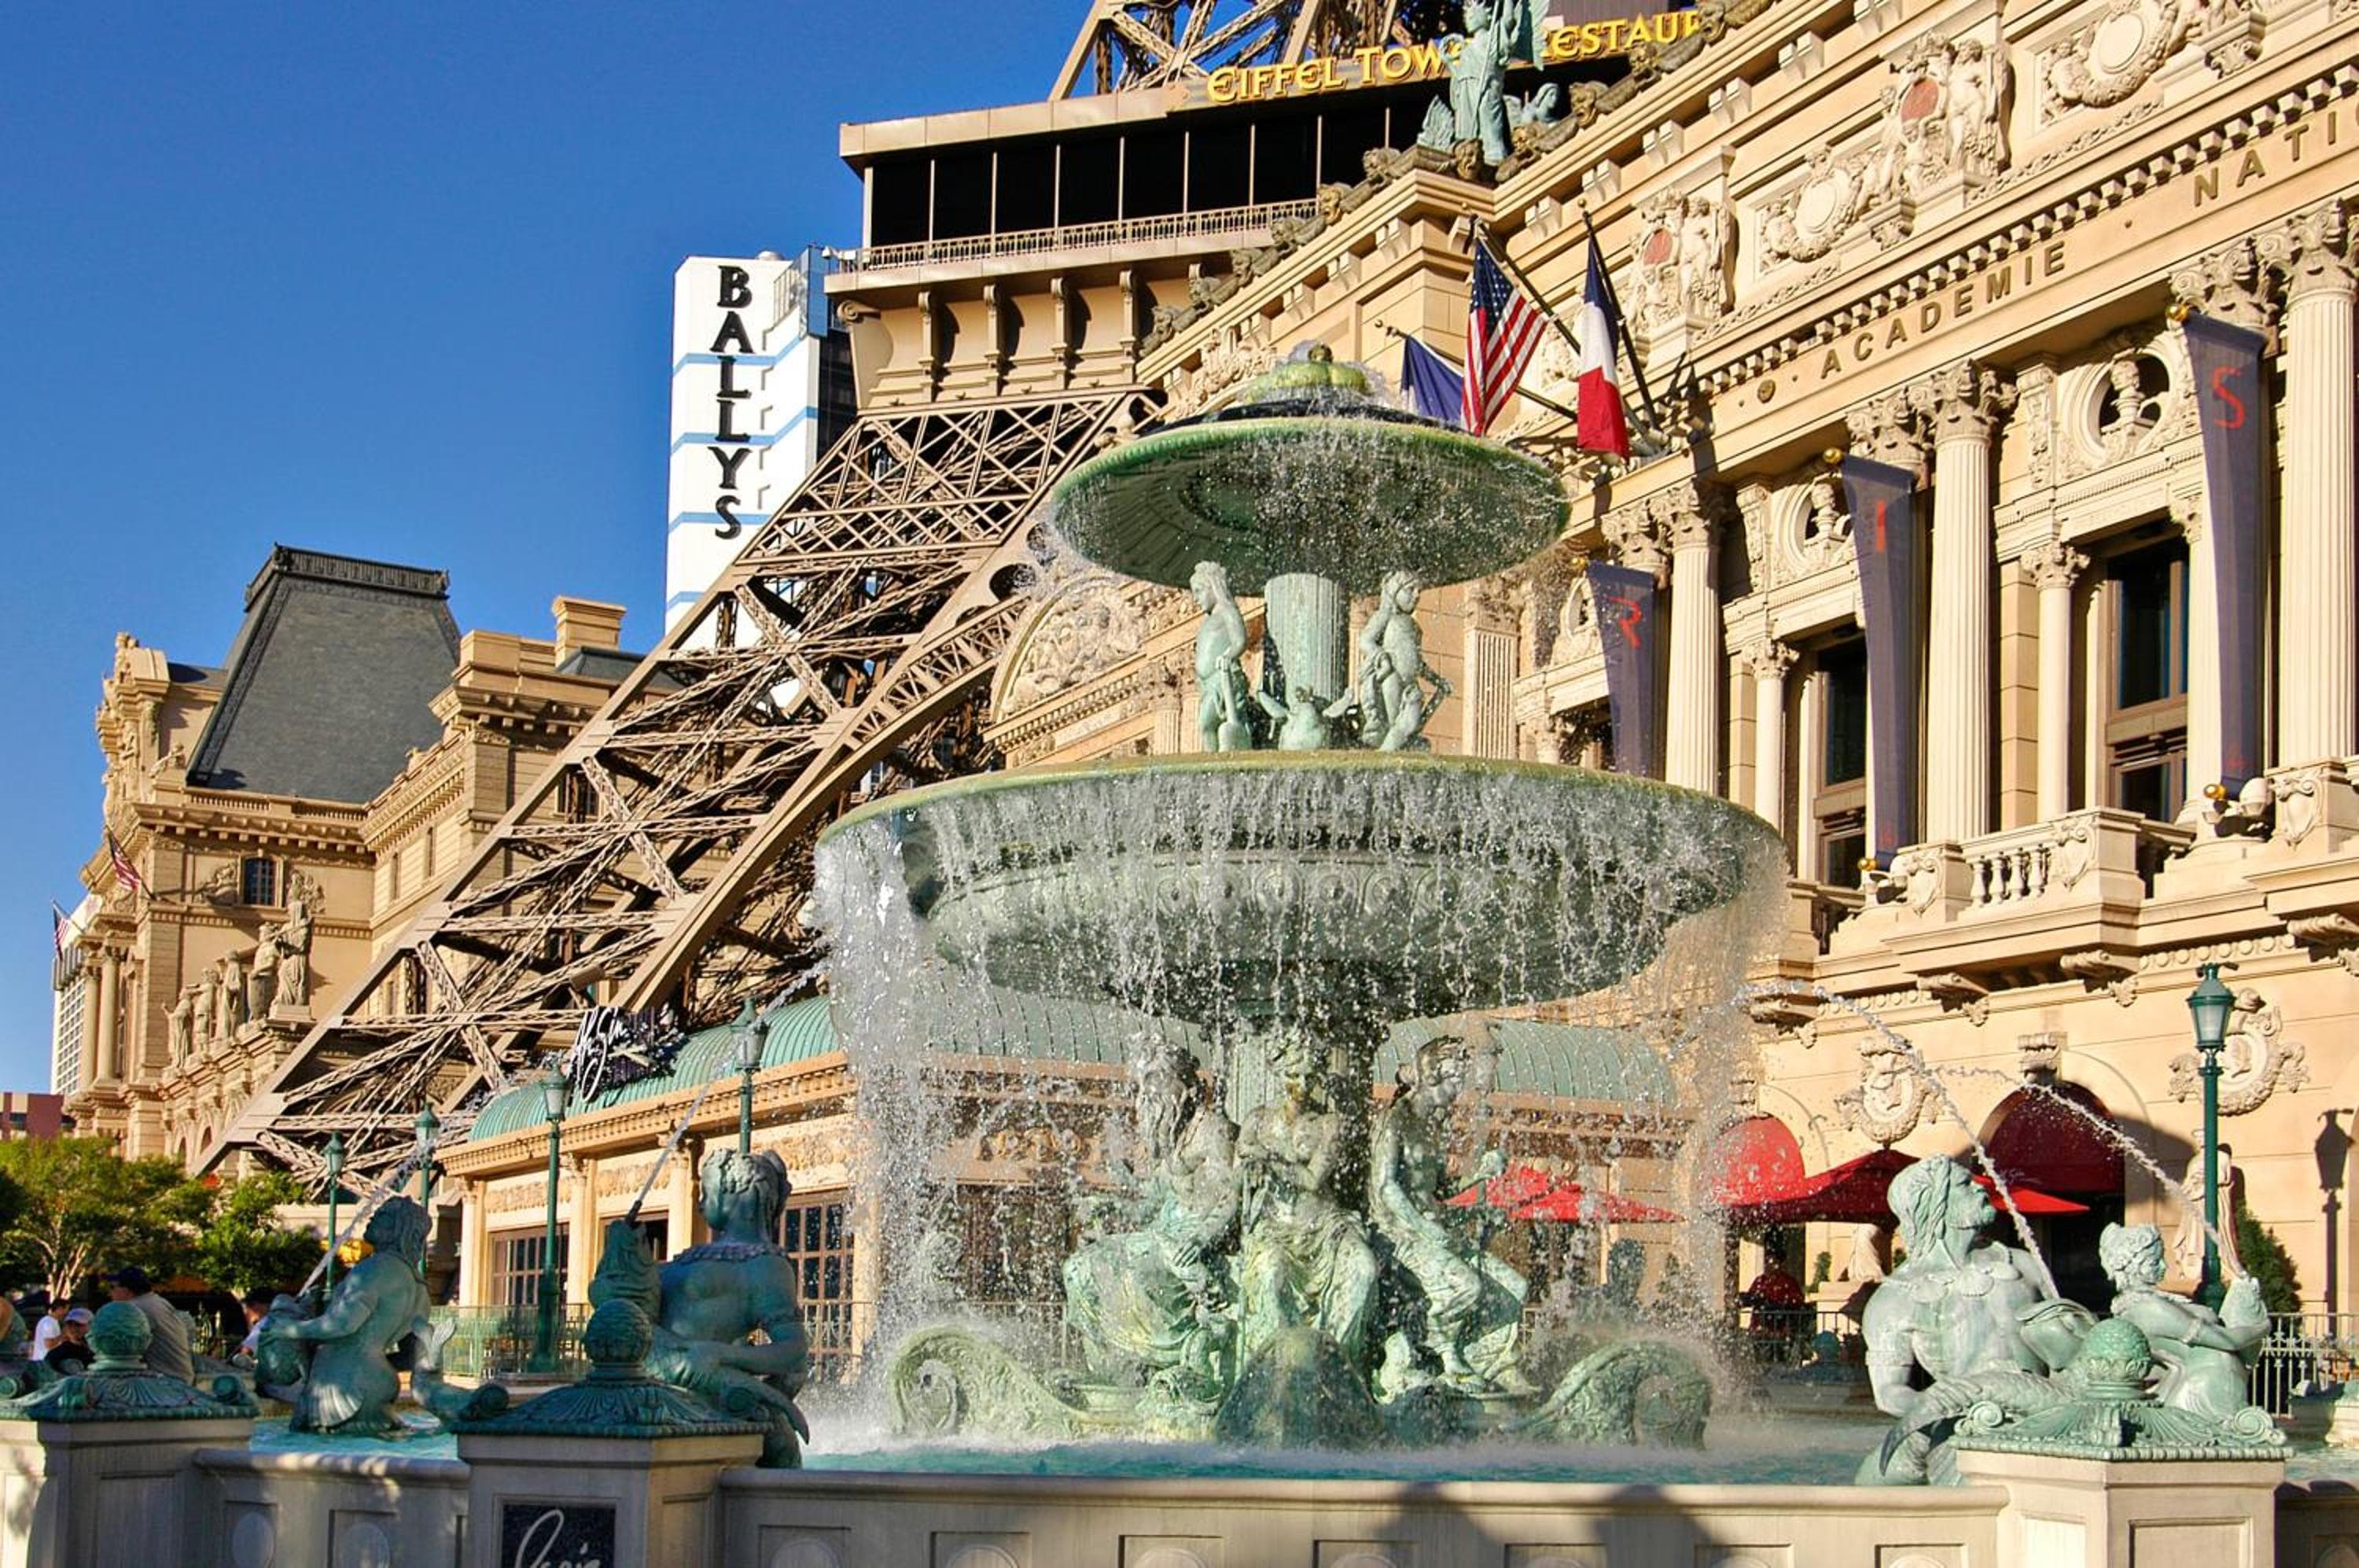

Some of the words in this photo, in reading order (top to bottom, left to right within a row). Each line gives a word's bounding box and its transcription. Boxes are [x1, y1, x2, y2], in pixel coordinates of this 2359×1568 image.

[1207, 56, 1345, 104] EIFFEL
[1352, 36, 1467, 85] TOW
[1820, 240, 2066, 379] ACADEMIE
[2194, 101, 2359, 208] NATI
[708, 264, 755, 540] BALLYS
[2210, 366, 2246, 429] S
